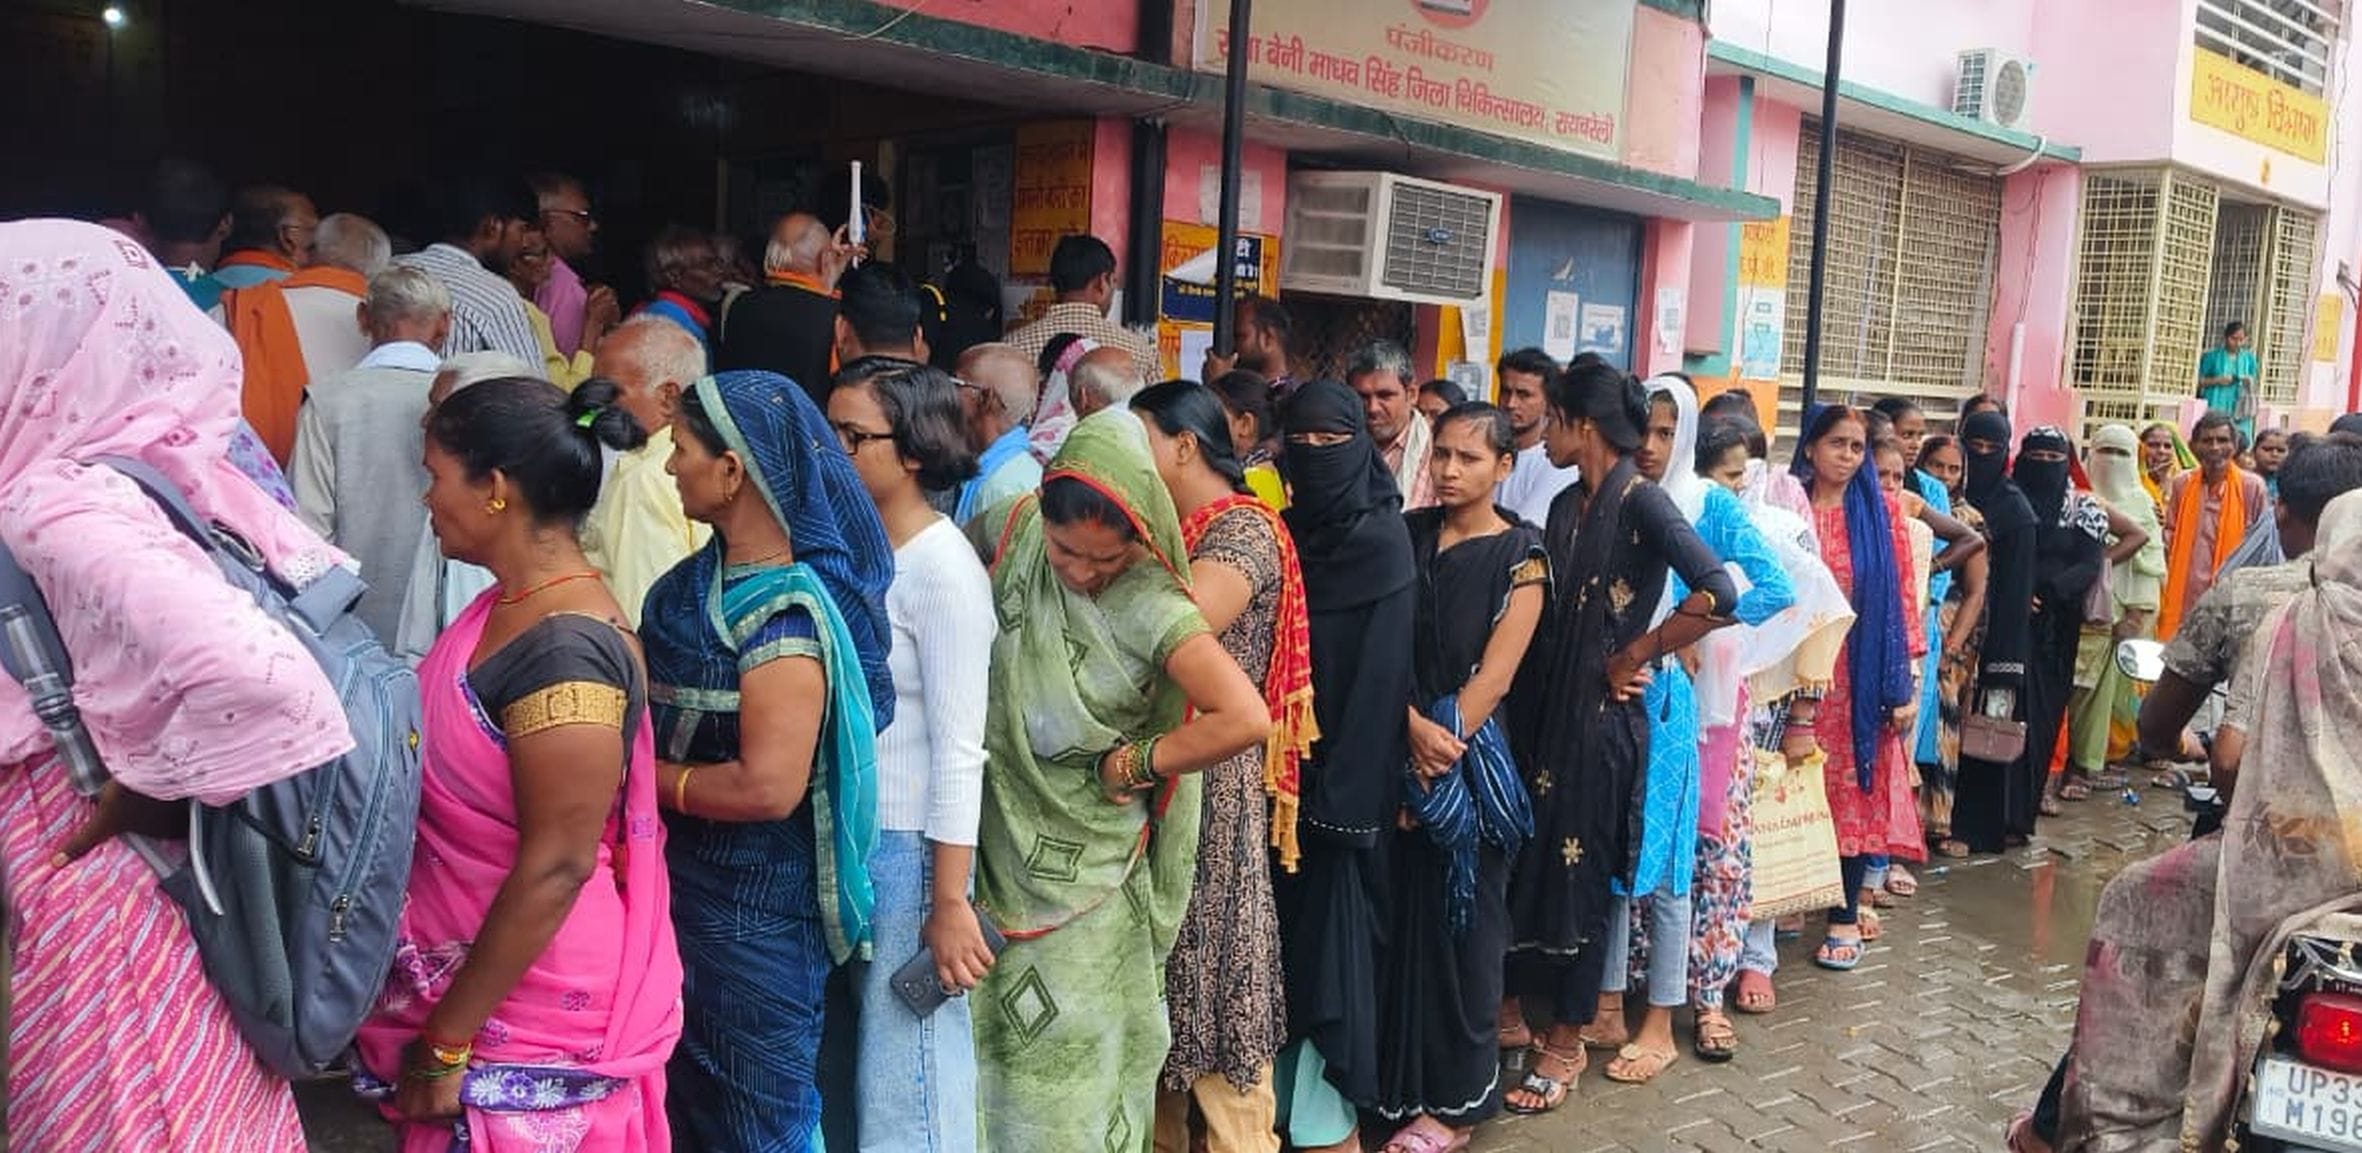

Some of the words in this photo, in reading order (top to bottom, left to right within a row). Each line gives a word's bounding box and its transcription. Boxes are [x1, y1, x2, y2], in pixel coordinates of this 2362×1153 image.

[1386, 23, 1494, 72] पंजीकरण
[1309, 51, 1360, 86] माधव
[1365, 55, 1401, 98] सिंह
[1405, 65, 1450, 108] जिला
[2267, 88, 2317, 144] विभाग
